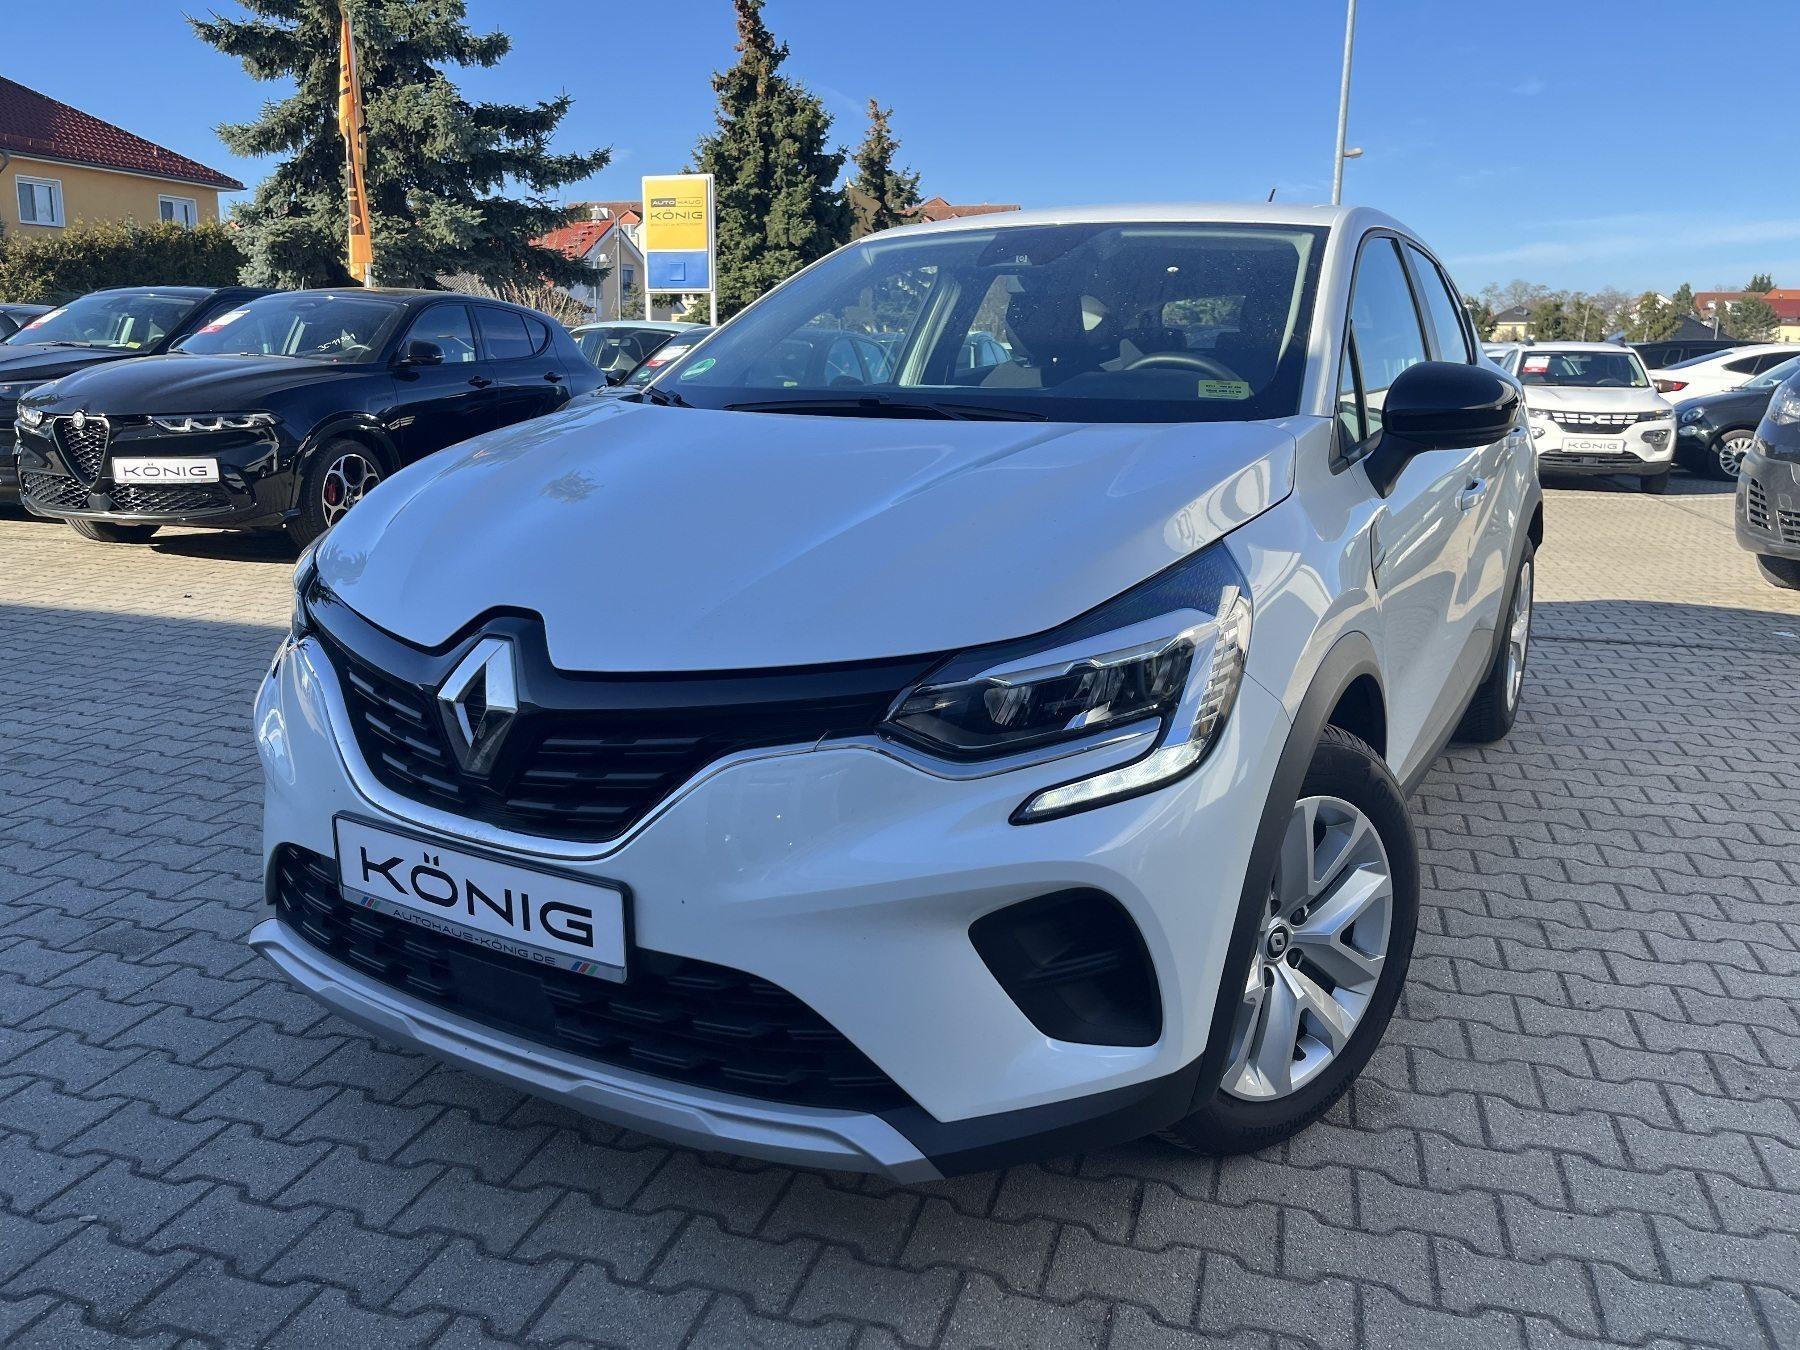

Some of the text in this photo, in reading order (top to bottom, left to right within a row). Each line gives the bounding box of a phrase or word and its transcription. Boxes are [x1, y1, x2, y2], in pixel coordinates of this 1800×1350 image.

[650, 208, 703, 220] KÖNIG
[1567, 440, 1618, 450] KÖNIG
[123, 462, 208, 477] KÖNIG
[360, 845, 594, 948] KÖNIG
[393, 908, 557, 966] AUTOHAUS-KÖNIG.DE
